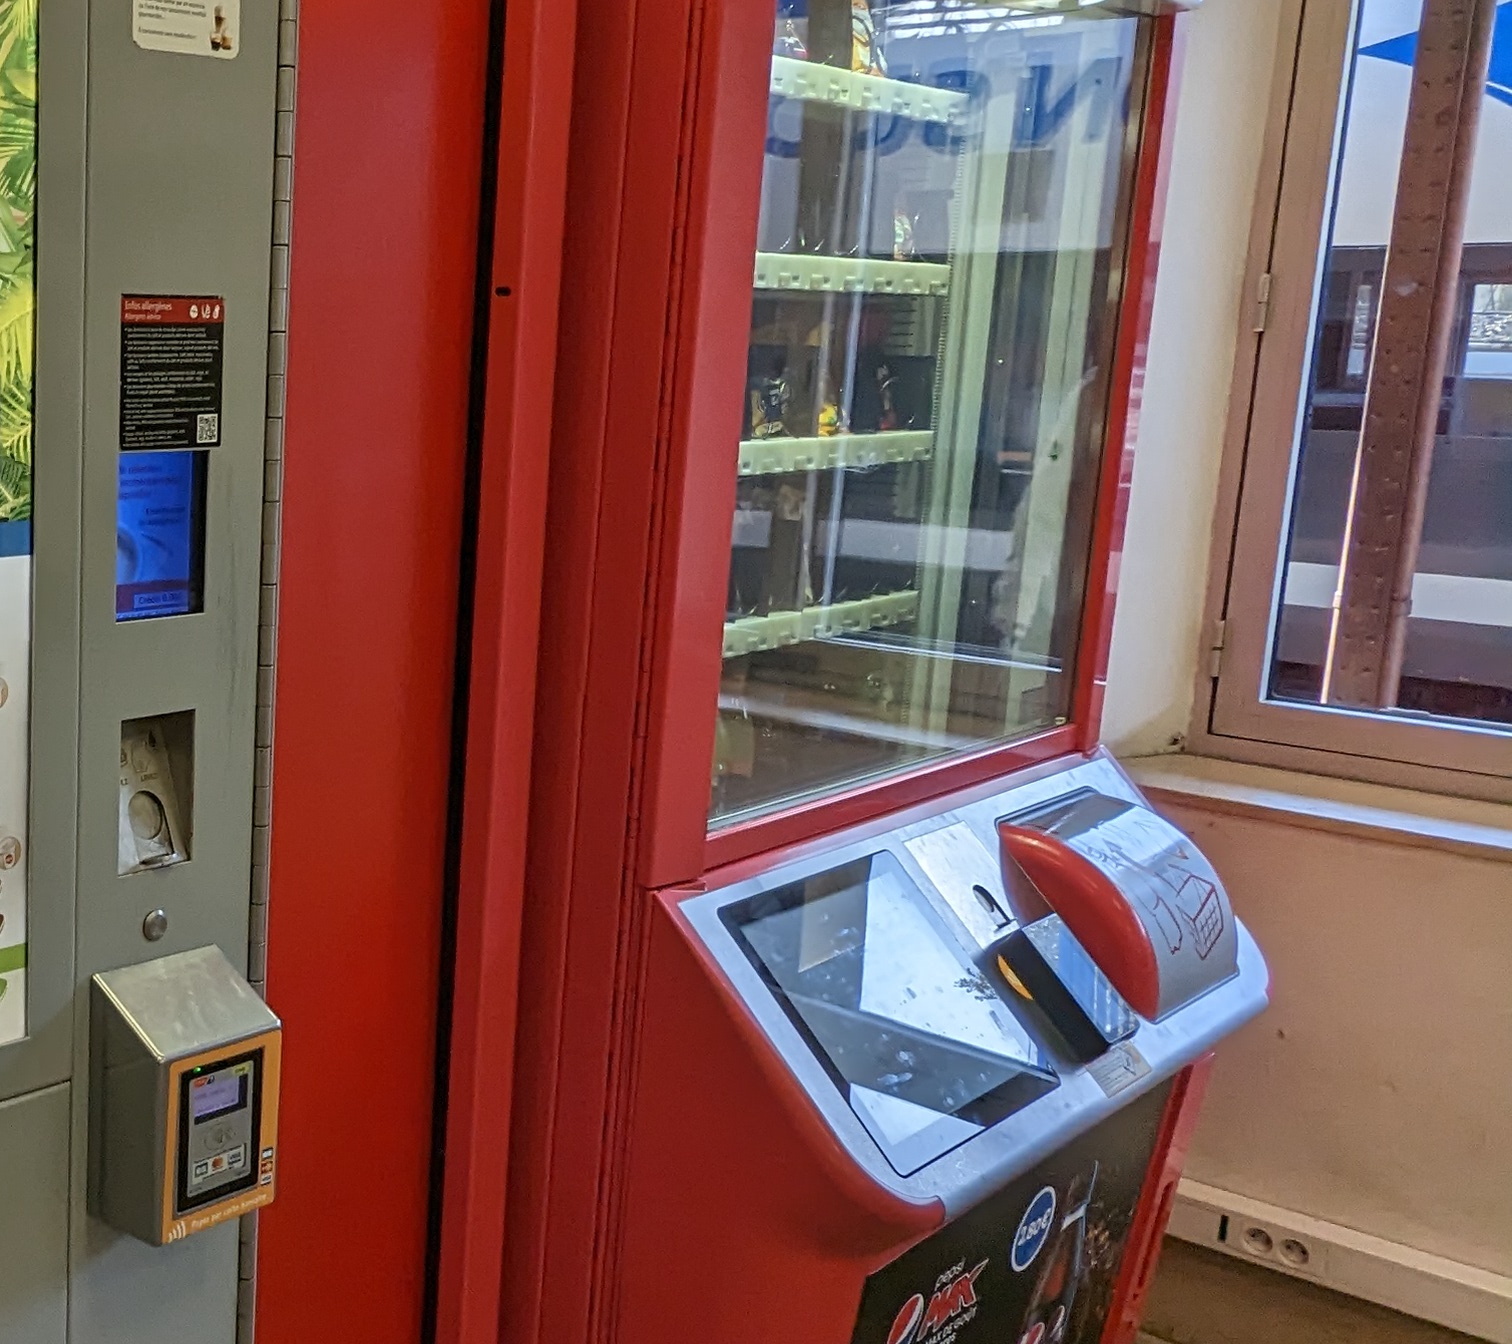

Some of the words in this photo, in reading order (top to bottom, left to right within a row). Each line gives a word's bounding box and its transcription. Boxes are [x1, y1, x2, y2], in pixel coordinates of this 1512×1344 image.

[934, 1256, 966, 1291] pepsi
[917, 1257, 990, 1341] MAX
[942, 1322, 953, 1338] DE
